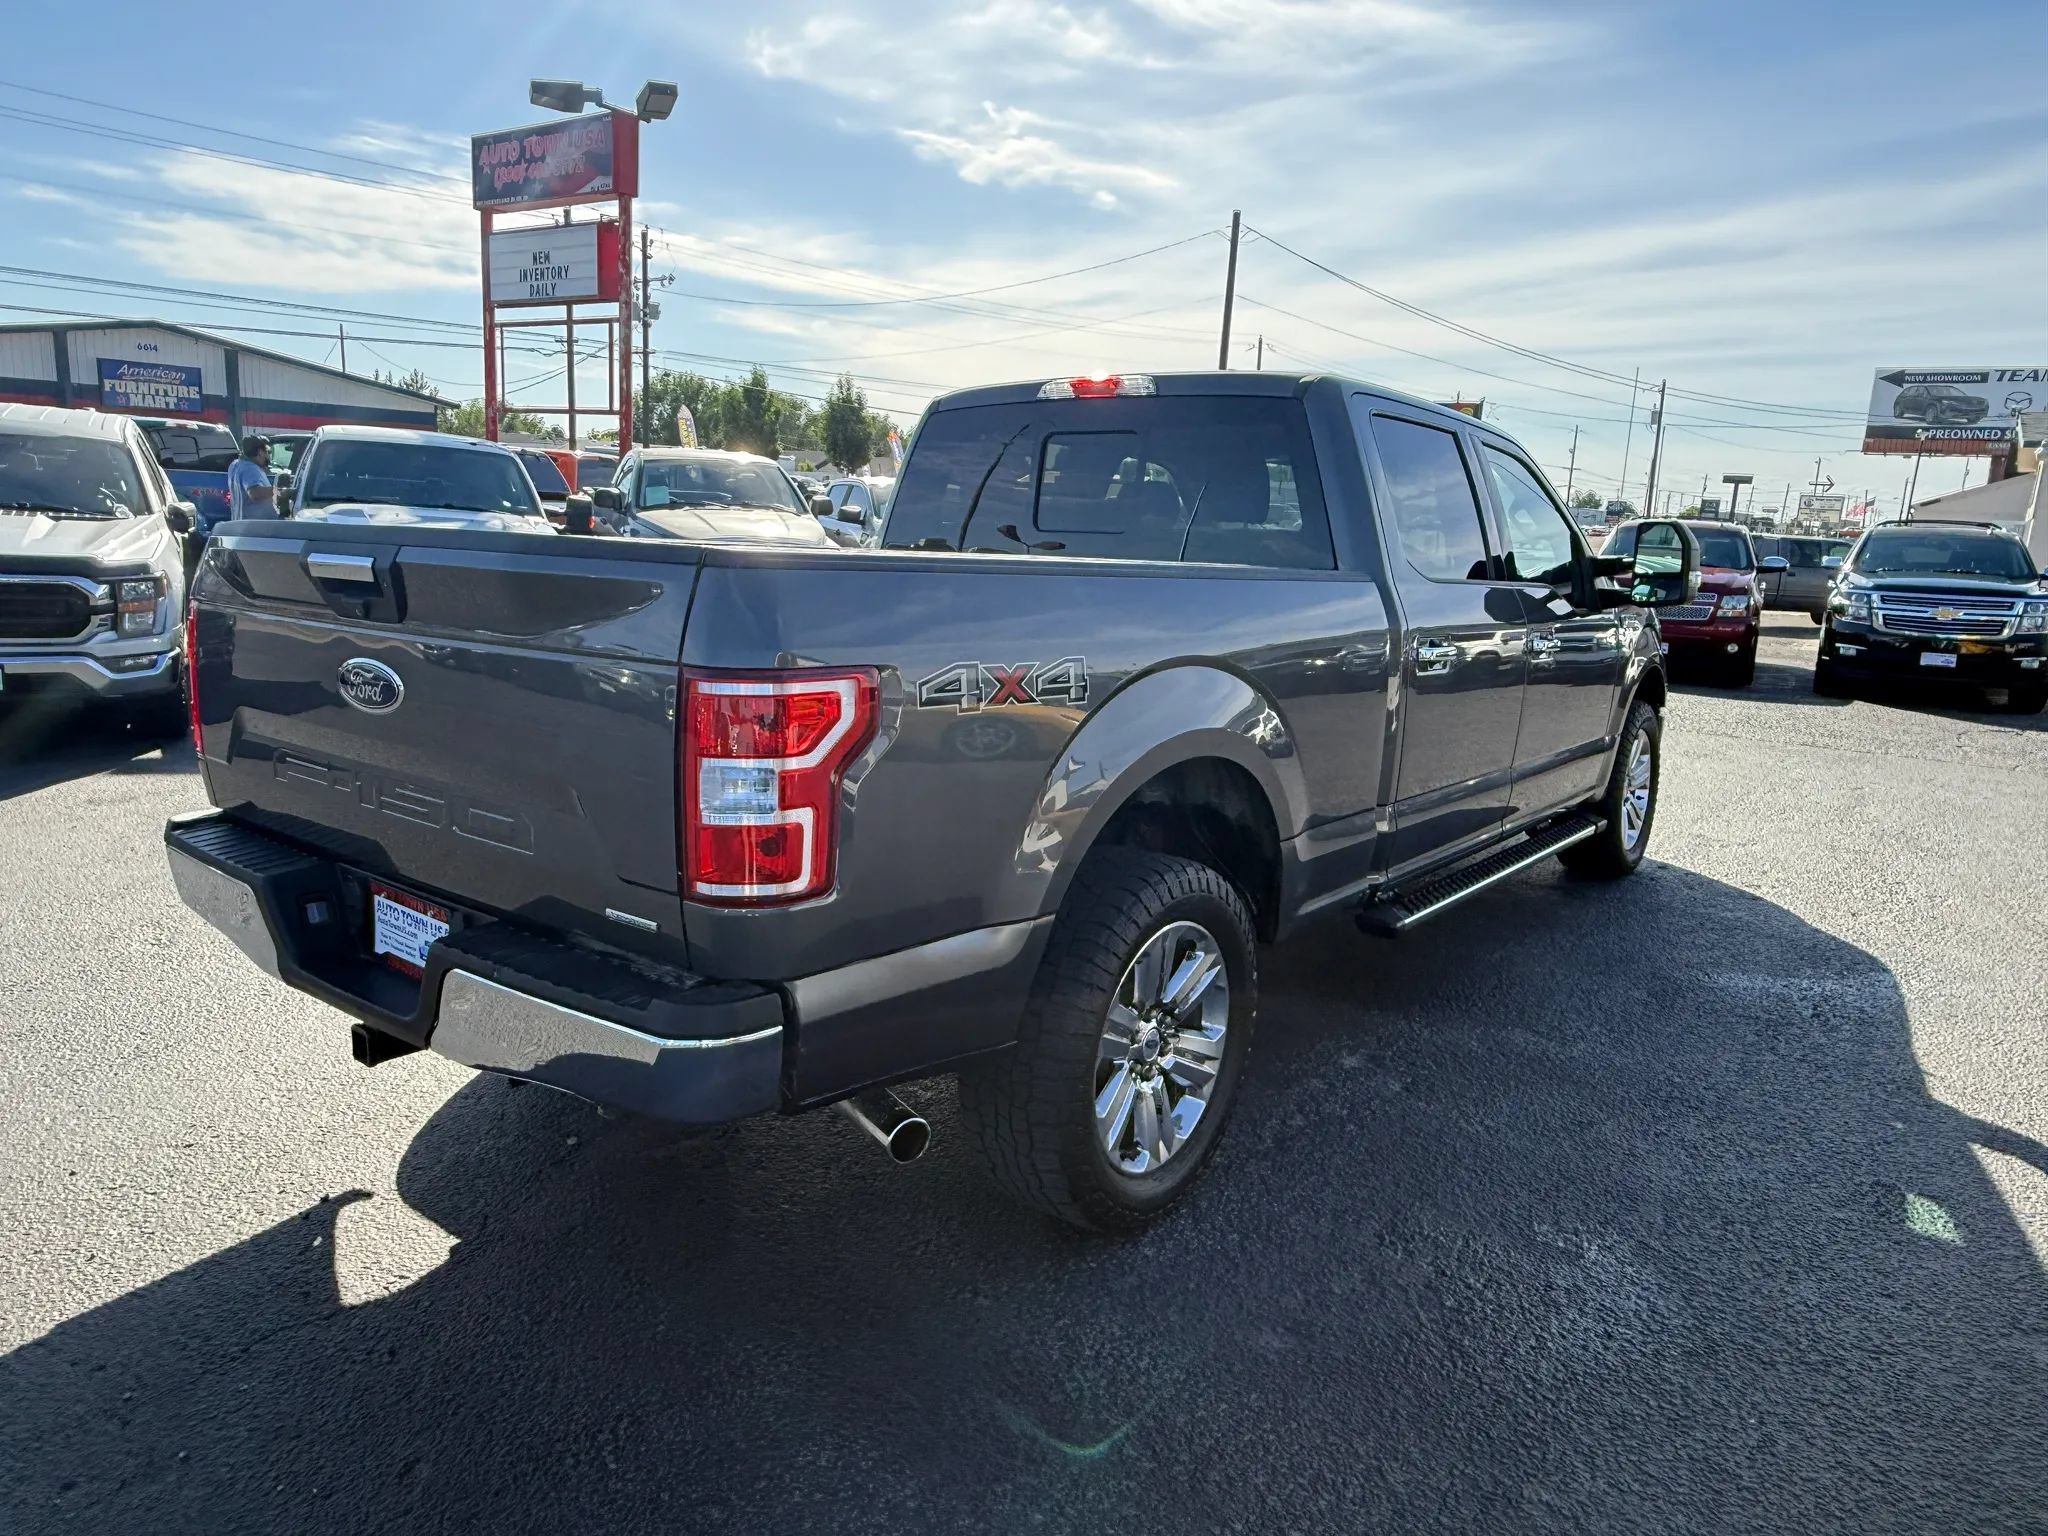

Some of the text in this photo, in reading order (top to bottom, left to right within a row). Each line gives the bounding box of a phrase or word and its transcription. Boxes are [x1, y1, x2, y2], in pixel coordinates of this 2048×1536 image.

[479, 126, 606, 166] AUTO TOWN USA
[532, 251, 550, 266] NEW
[520, 265, 569, 282] INVENTORY
[529, 283, 556, 297] DAILY
[117, 364, 186, 380] American
[1904, 374, 1981, 382] NEW SHOWROOM
[103, 379, 200, 399] FURNITURE
[129, 393, 178, 409] MART
[1929, 429, 2001, 439] PREOWNED
[347, 668, 384, 702] Ford
